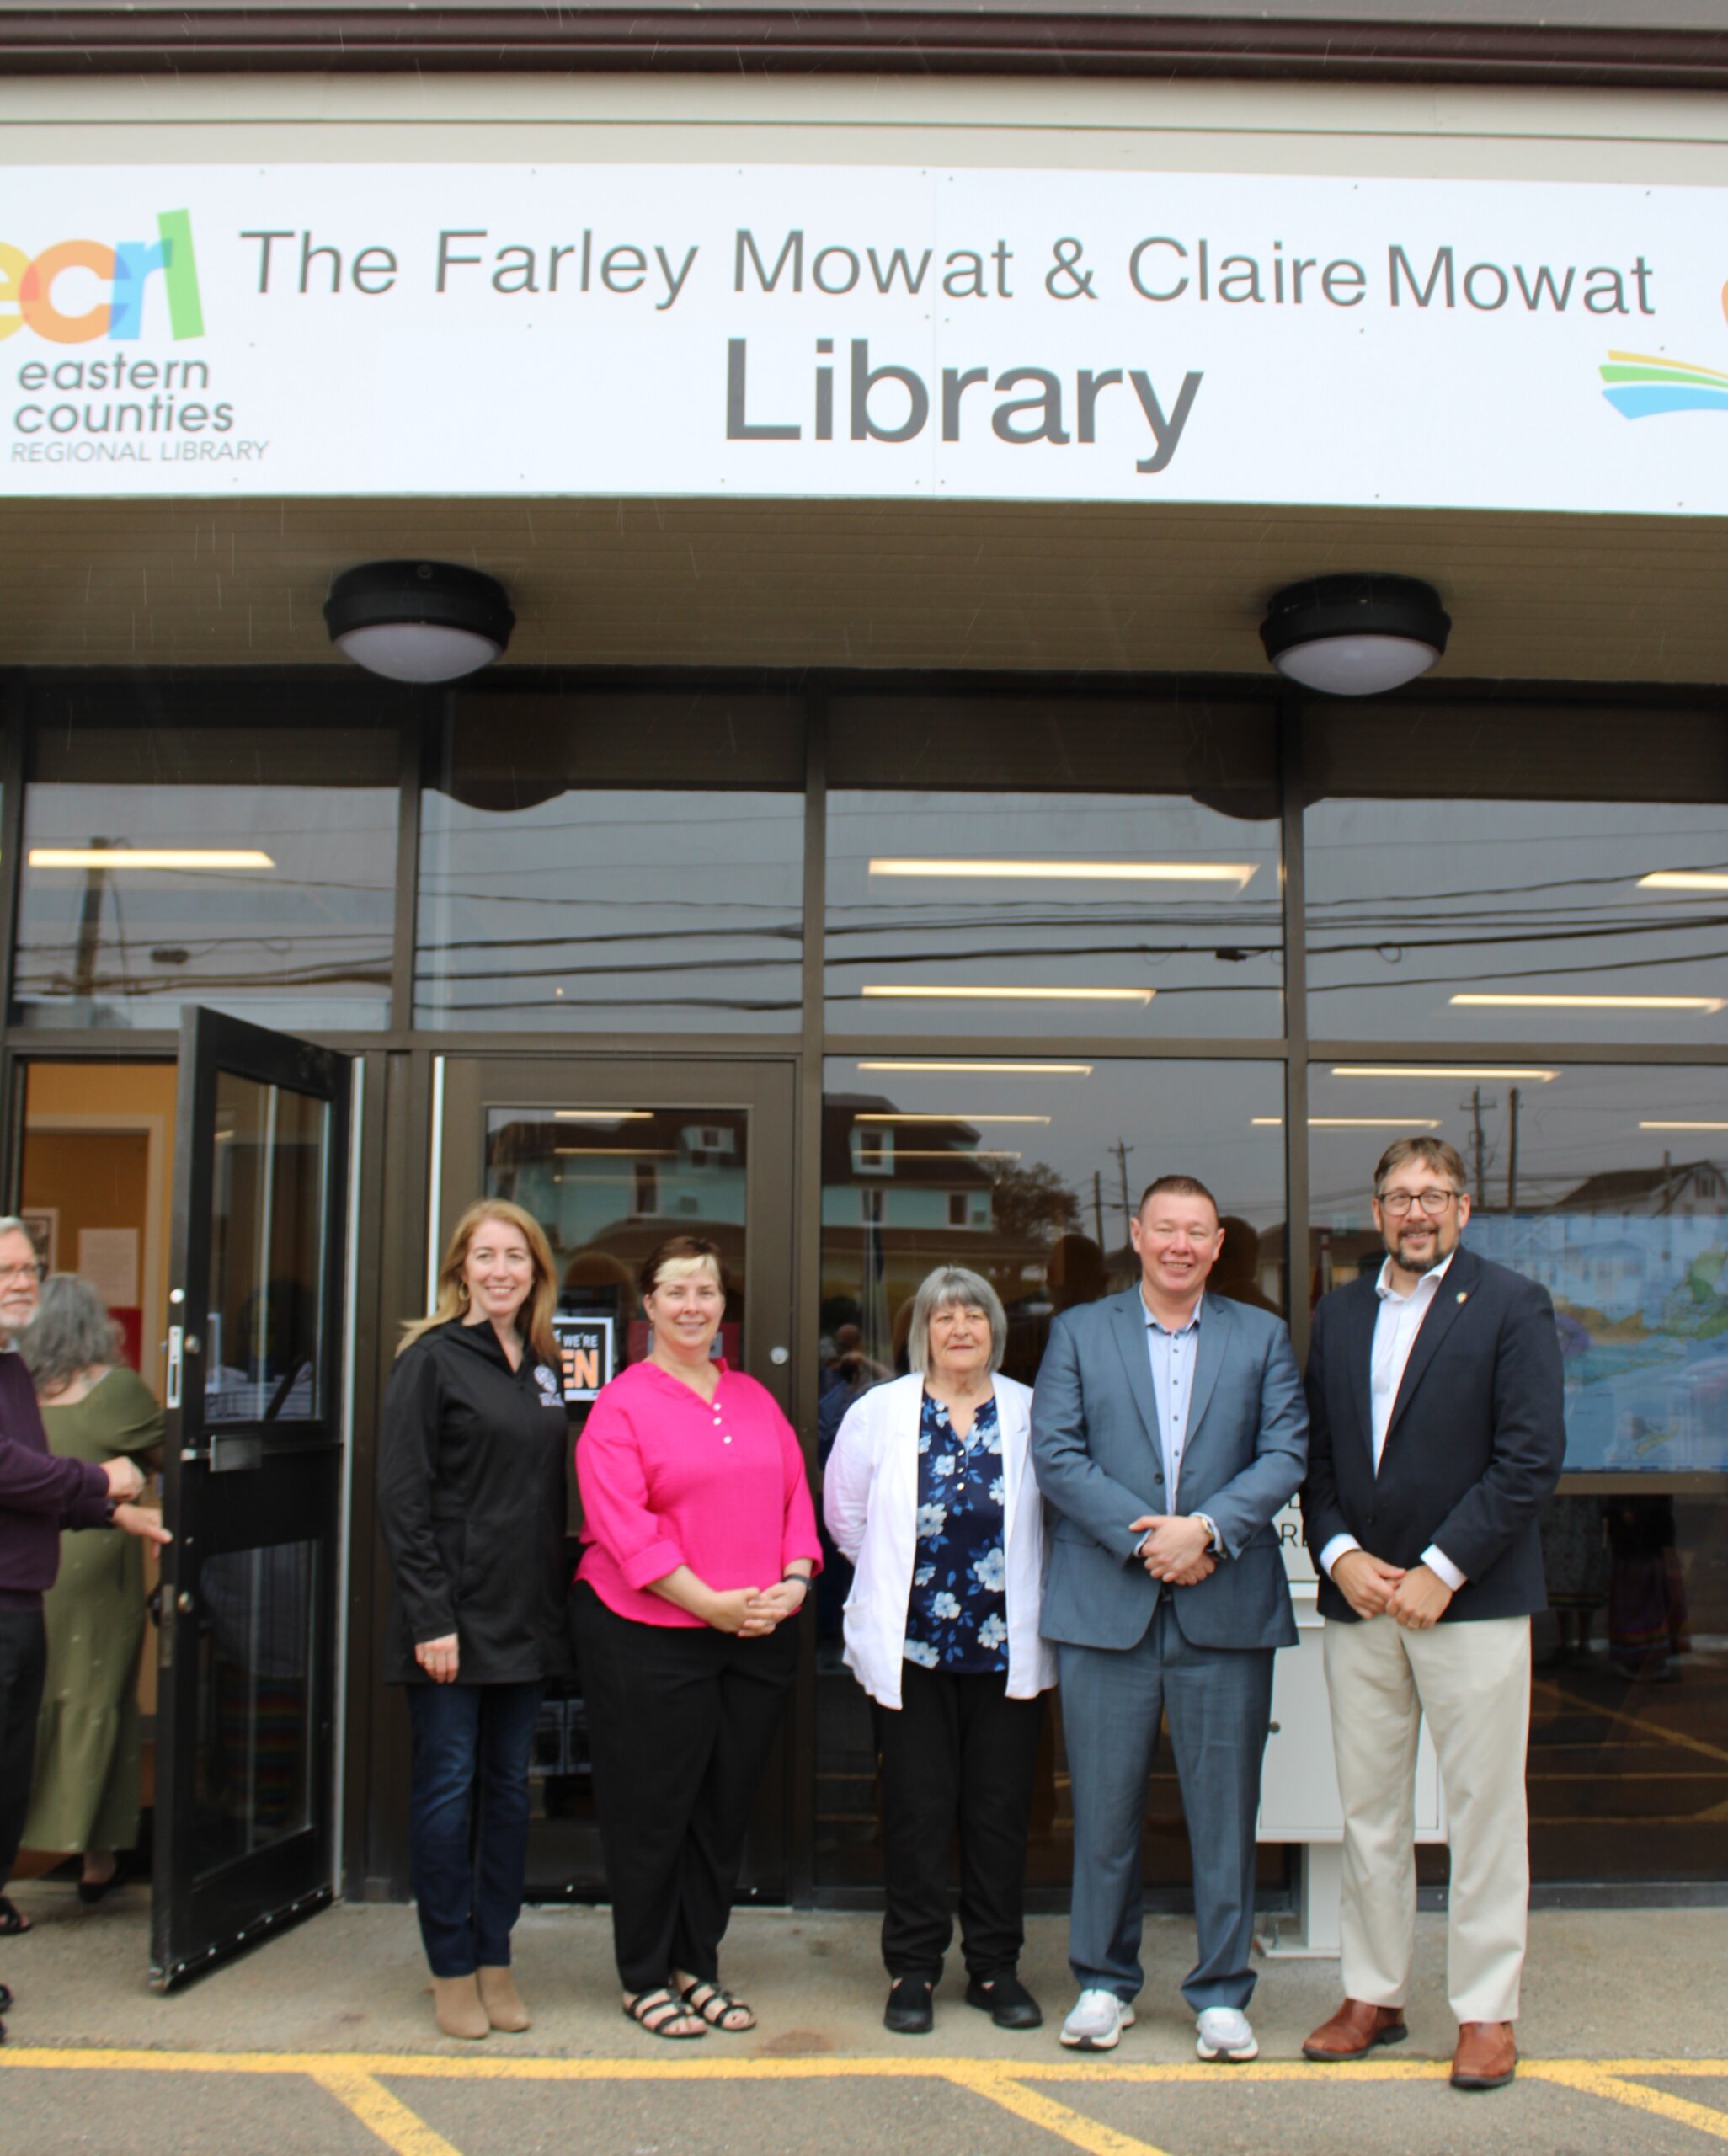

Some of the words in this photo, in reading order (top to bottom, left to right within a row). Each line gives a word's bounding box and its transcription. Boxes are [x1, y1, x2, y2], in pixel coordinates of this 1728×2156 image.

[239, 229, 398, 295] The
[435, 228, 699, 311] Farley
[733, 228, 1014, 299] Mowat
[1044, 237, 1098, 301] &
[1128, 236, 1367, 307] Claire
[1388, 244, 1656, 316] Mowat
[18, 352, 209, 391] eastern
[13, 394, 233, 435] counties
[726, 338, 1204, 474] Library
[11, 441, 151, 463] REGIONAL
[160, 440, 269, 461] LIBRARY
[560, 1348, 599, 1389] EN
